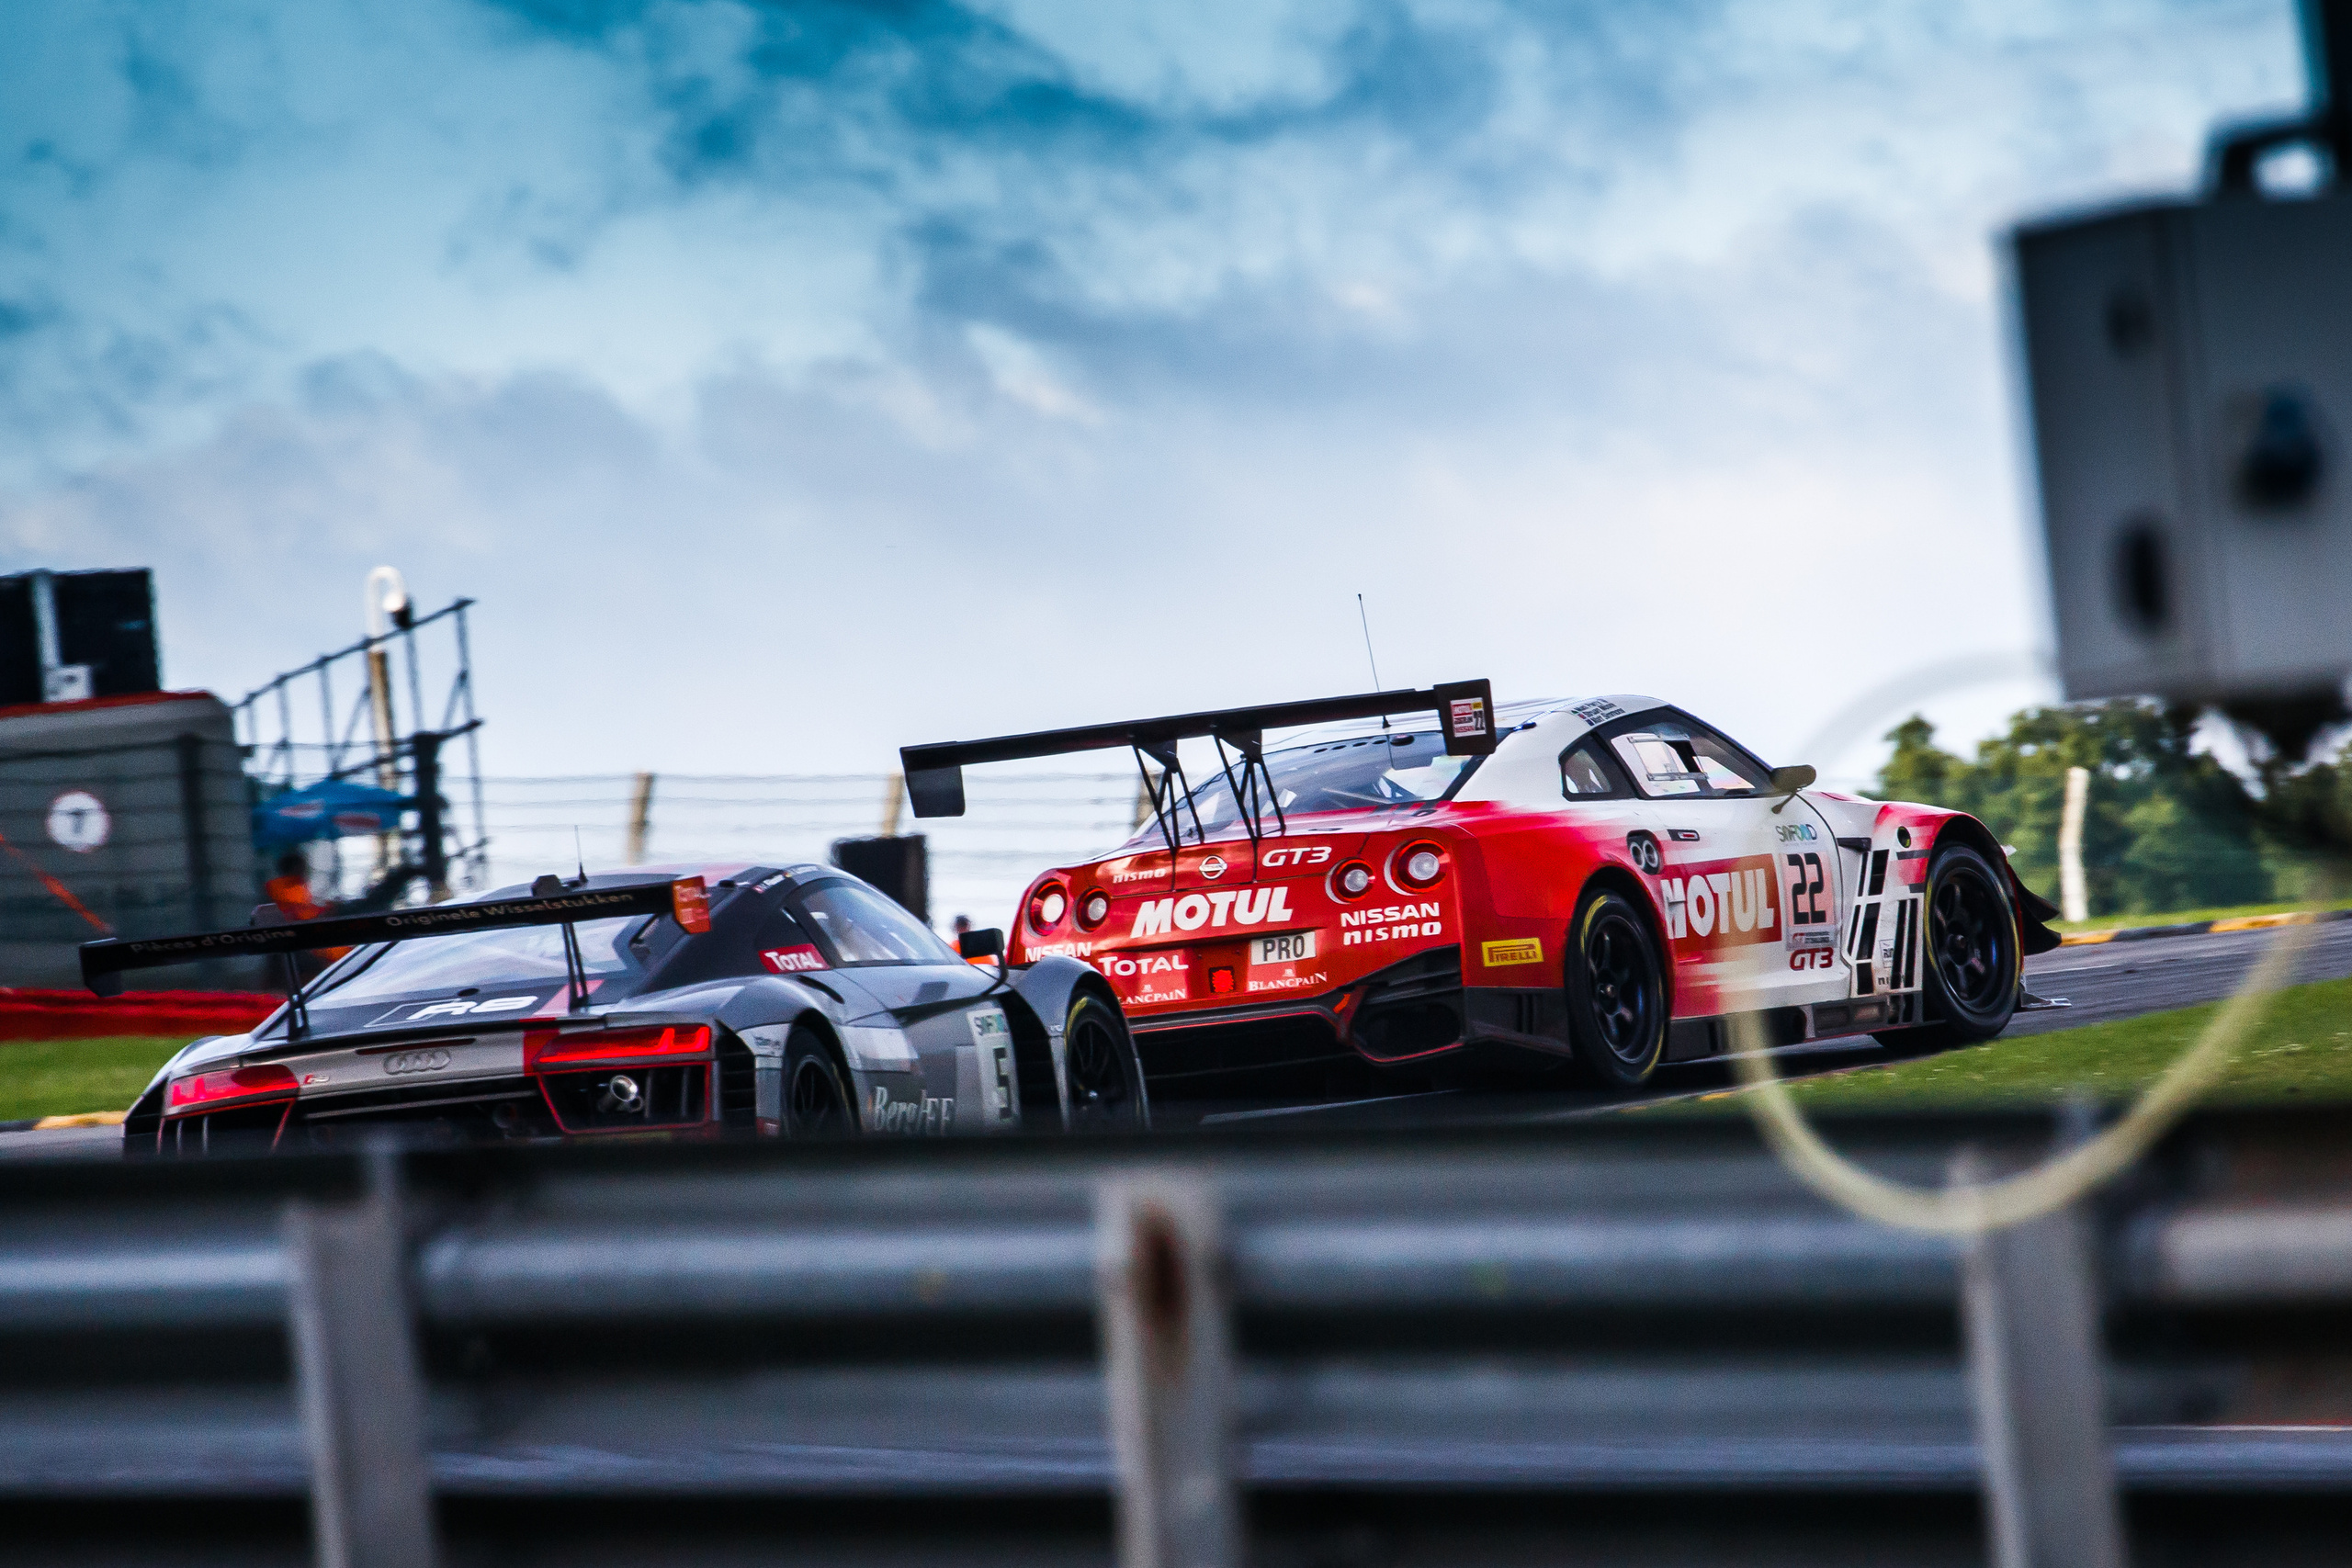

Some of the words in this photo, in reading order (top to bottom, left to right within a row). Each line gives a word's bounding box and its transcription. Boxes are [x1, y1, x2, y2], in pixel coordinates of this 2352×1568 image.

[1262, 846, 1332, 867] GT3
[1113, 868, 1166, 884] nismo
[1786, 852, 1826, 924] 22
[1130, 886, 1294, 939] MOTUL
[1340, 902, 1441, 928] NISSAN
[1660, 868, 1775, 940] MOTUL
[386, 908, 482, 928] Originele
[1342, 921, 1442, 946] nismo
[1024, 942, 1092, 963] NISSAN
[1261, 935, 1306, 963] PRO
[1487, 943, 1538, 963] PIRELLI
[1789, 947, 1834, 971] GT3
[405, 996, 538, 1021] R8
